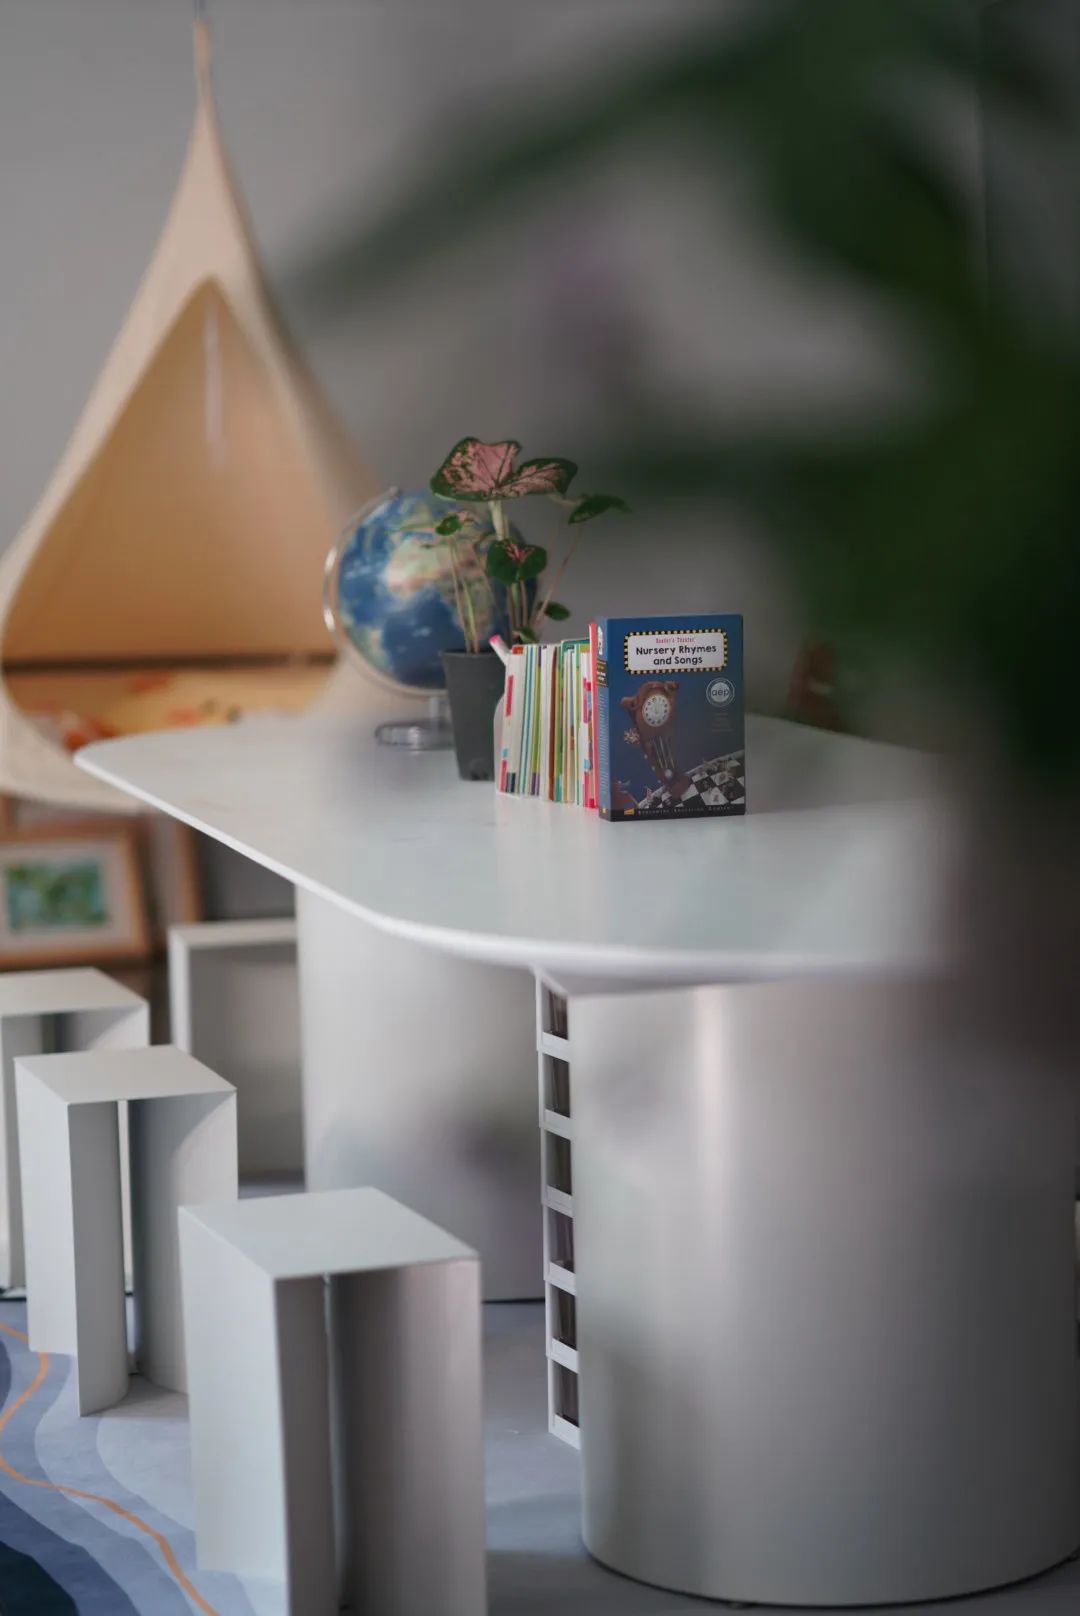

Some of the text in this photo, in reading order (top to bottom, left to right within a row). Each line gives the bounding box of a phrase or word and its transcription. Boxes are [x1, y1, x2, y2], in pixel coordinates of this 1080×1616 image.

[635, 645, 717, 656] Nursery Rhymes
[653, 656, 703, 666] and Songs
